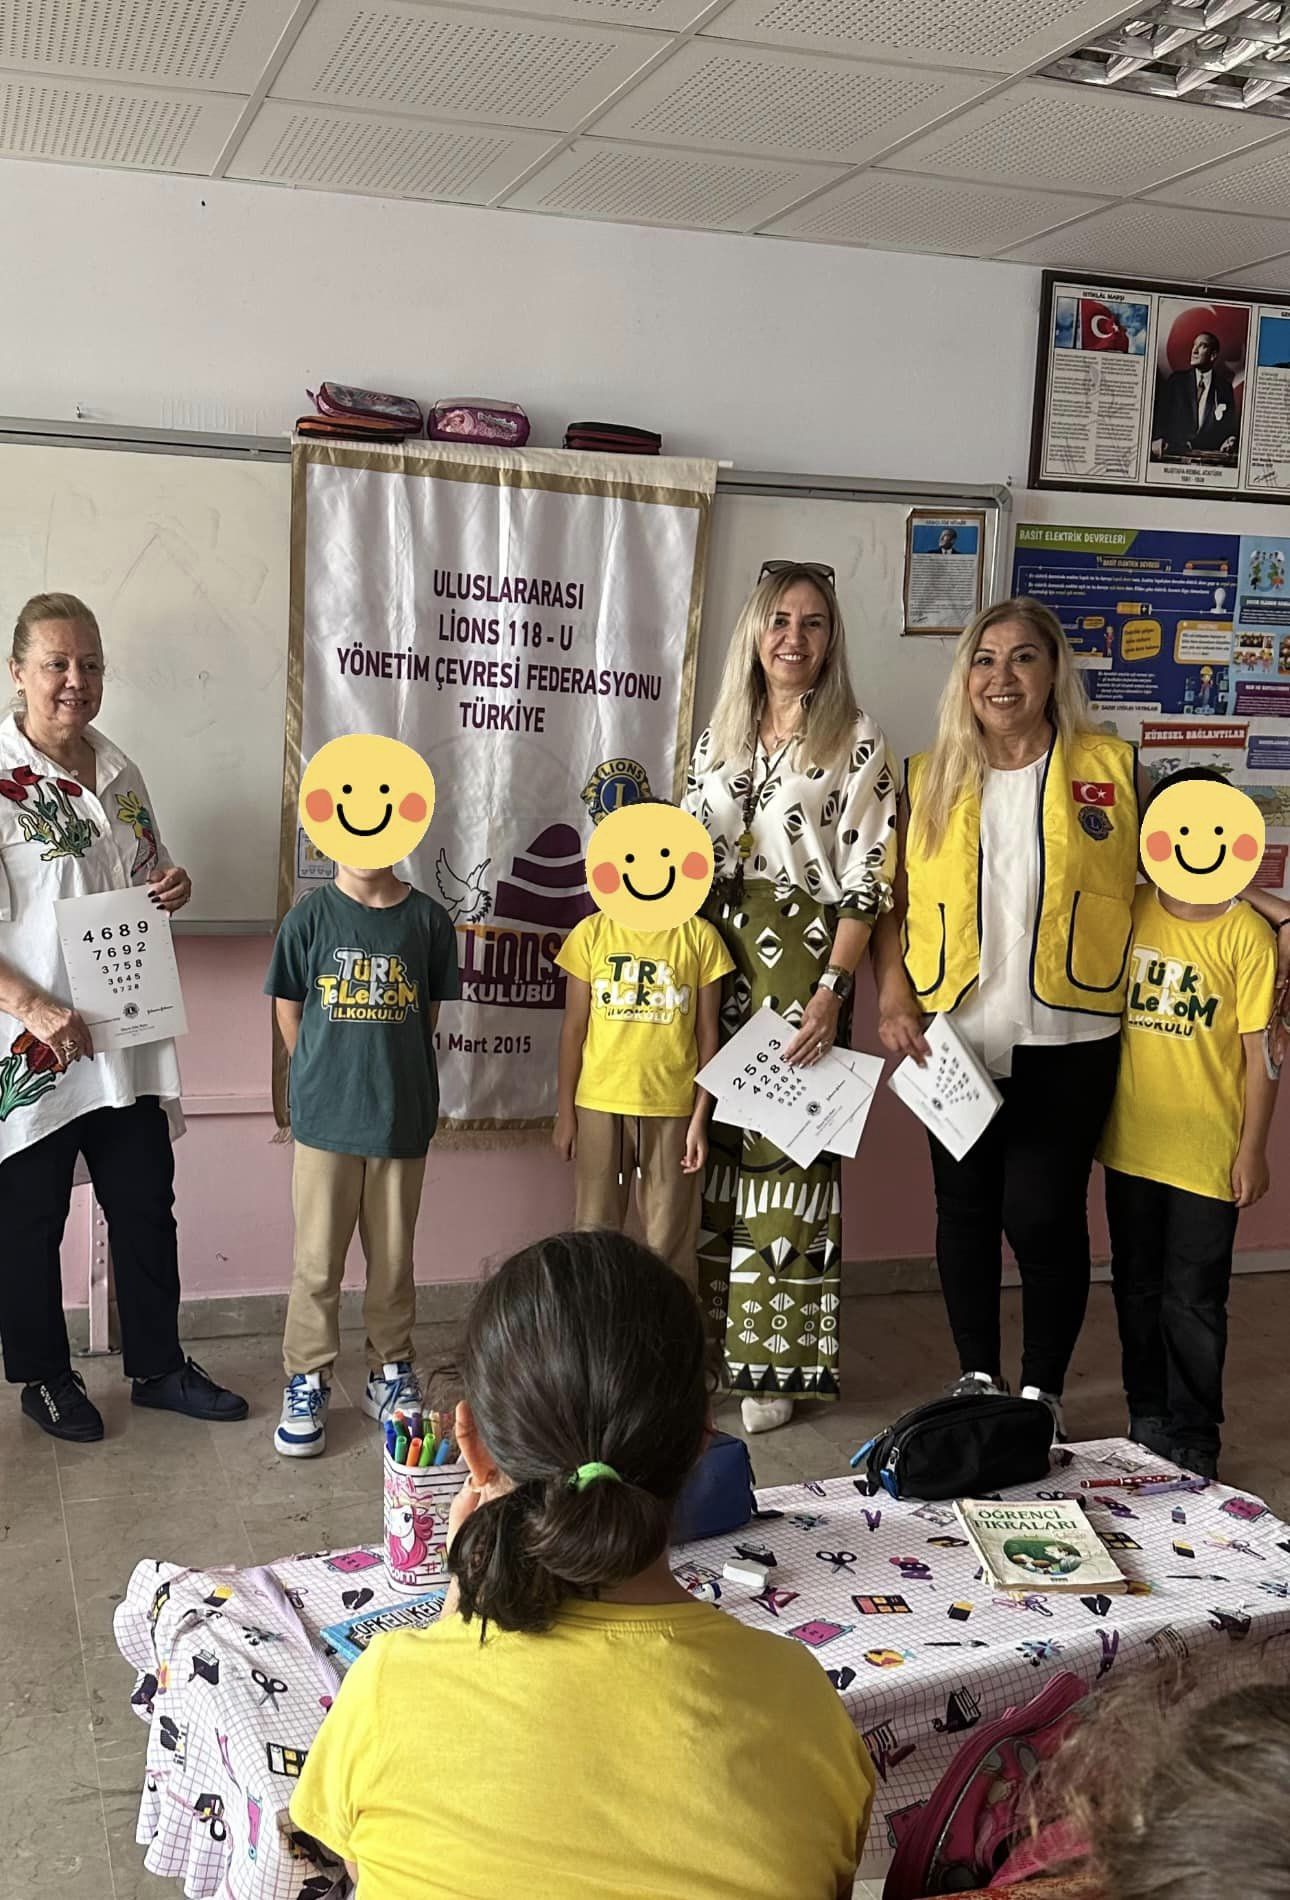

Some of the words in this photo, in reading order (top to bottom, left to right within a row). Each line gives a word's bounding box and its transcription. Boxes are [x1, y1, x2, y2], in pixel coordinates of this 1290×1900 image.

[1045, 531, 1082, 542] ELEKTRİK
[1084, 532, 1126, 545] DEVRELERİ
[433, 570, 584, 610] ULUSLARARASI
[439, 608, 499, 645] LİONS
[509, 620, 542, 646] 118
[560, 625, 573, 651] U
[337, 642, 430, 682] YÖNETİM
[435, 655, 520, 691] ÇEVRESİ
[526, 664, 662, 700] FEDERASYONU
[459, 696, 545, 733] TÜRKİYE
[1144, 729, 1184, 740] KÜRESEL
[601, 761, 643, 780] LIONS
[462, 980, 555, 1002] KULÜBÜ
[449, 1033, 488, 1053] Mart
[493, 1036, 531, 1053] 2015
